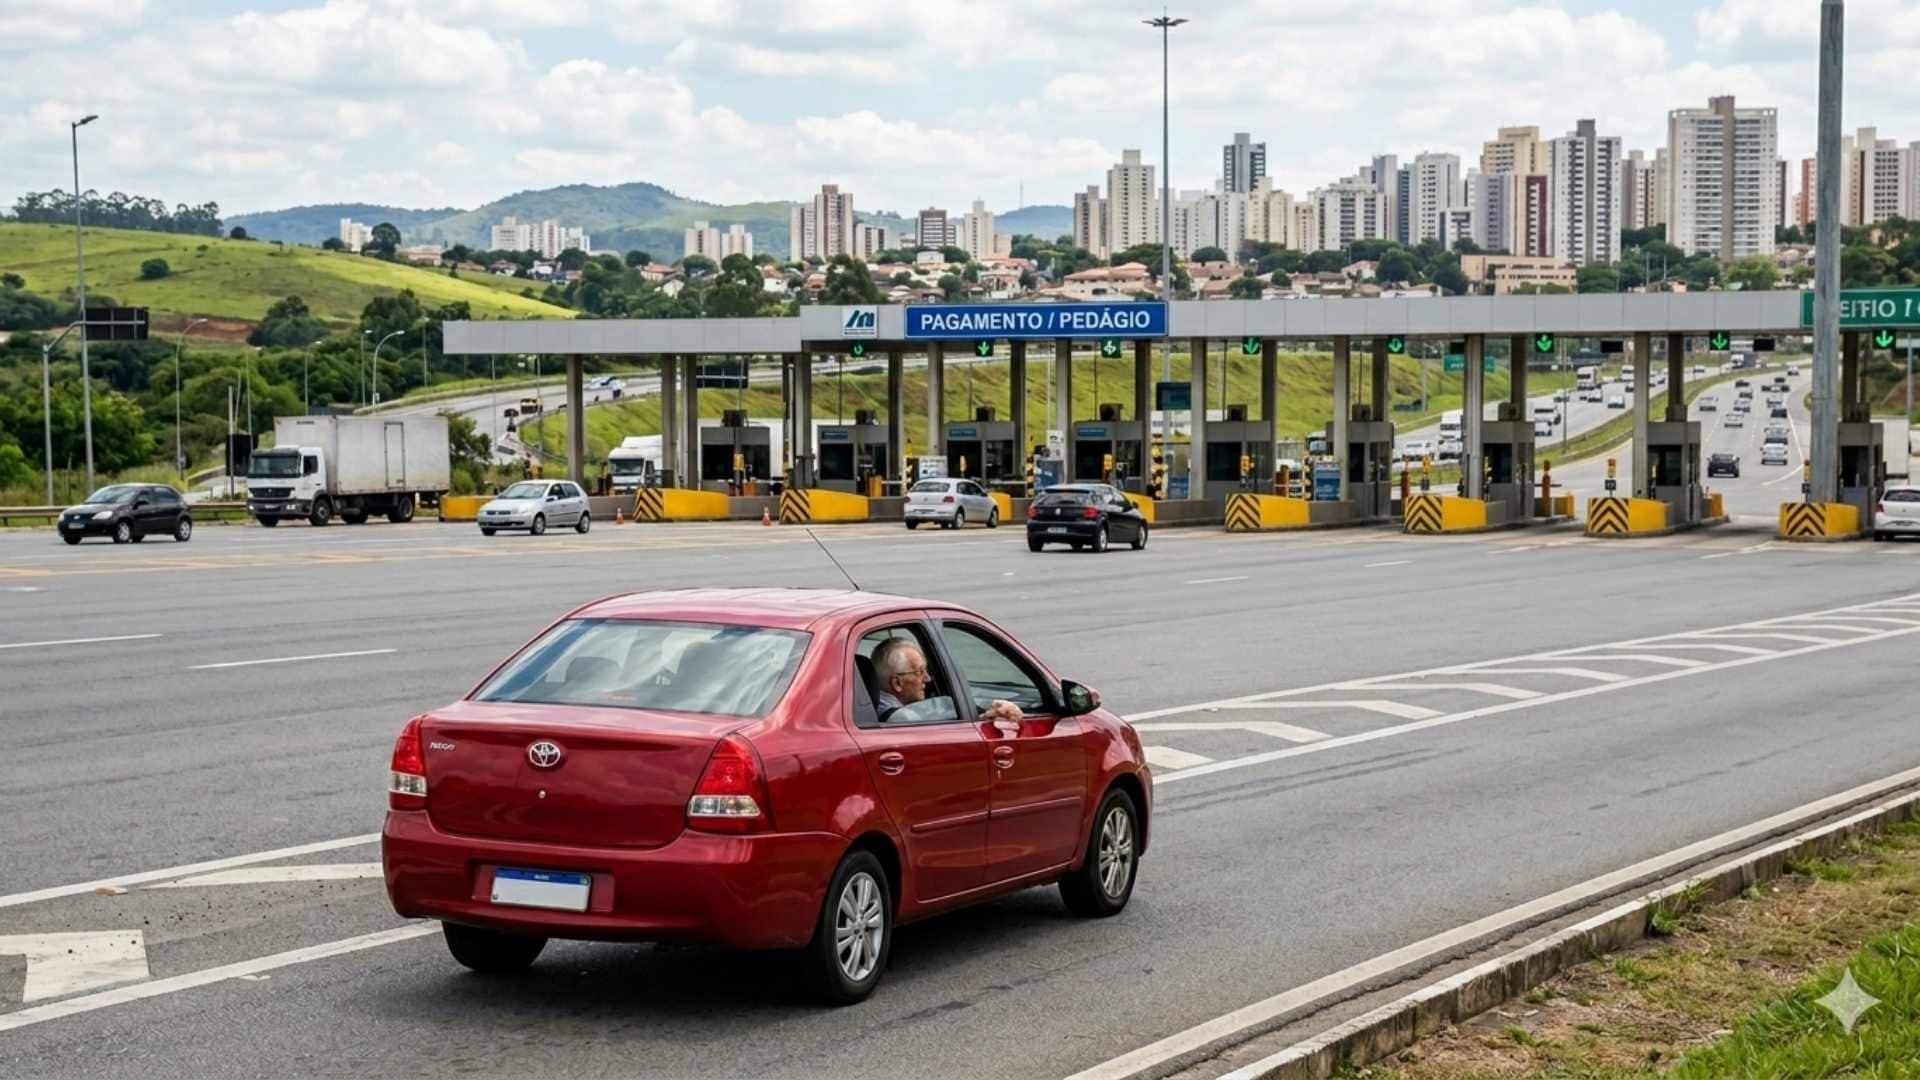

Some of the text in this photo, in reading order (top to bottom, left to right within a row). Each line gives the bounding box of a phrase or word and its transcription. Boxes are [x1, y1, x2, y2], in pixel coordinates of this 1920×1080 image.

[920, 306, 1151, 331] PAGAMENTO / PEDÁGIO
